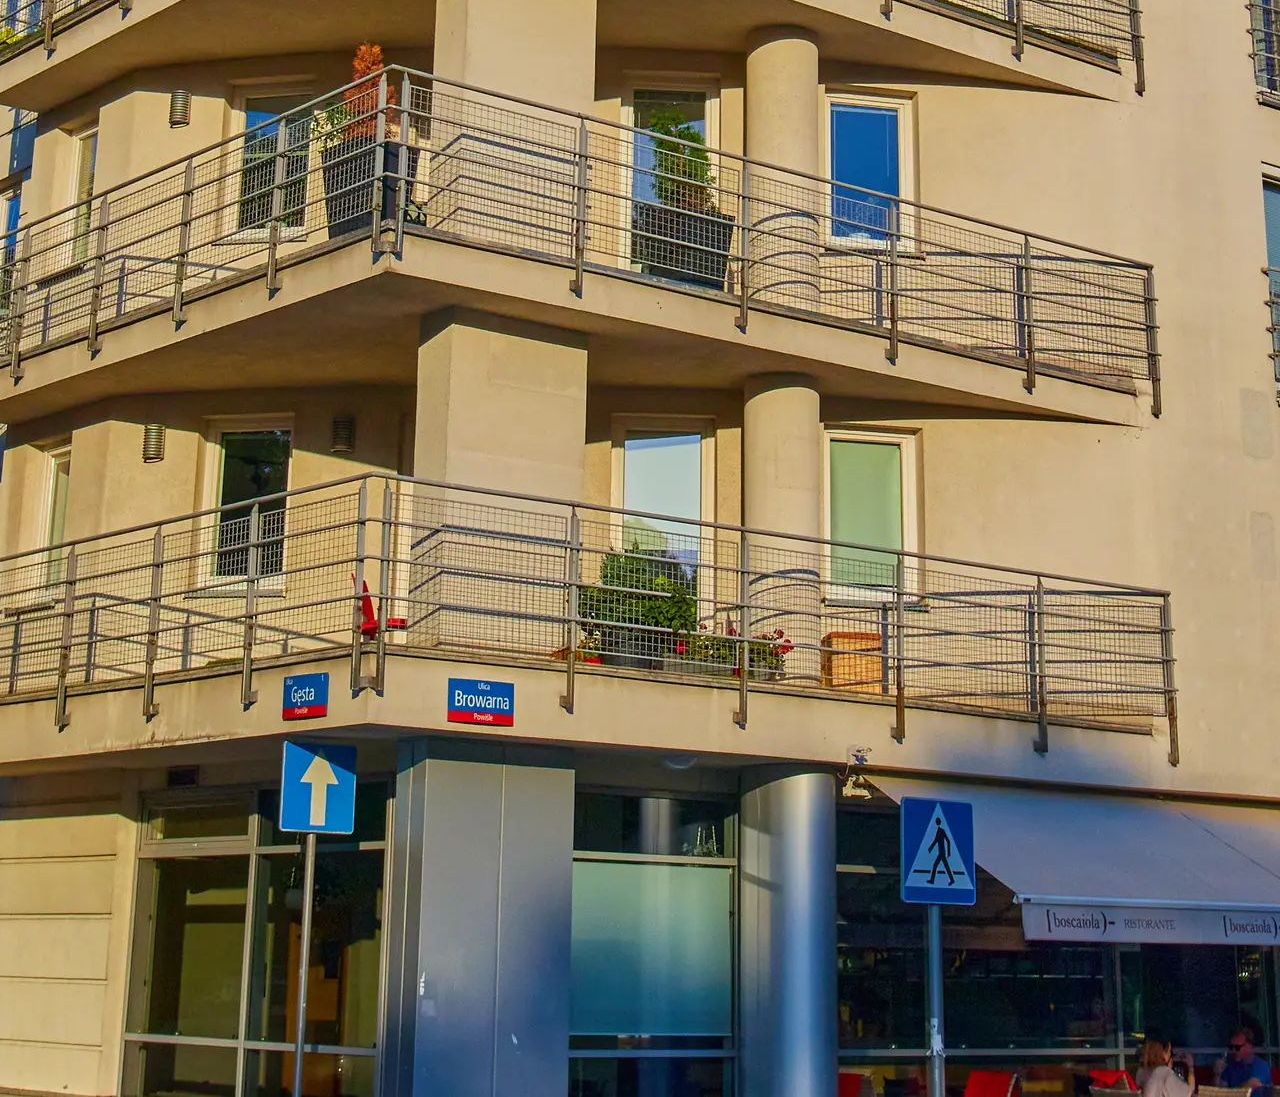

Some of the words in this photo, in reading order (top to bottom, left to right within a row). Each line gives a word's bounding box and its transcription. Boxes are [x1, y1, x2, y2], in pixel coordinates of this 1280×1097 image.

[477, 682, 491, 691] Ulica
[291, 686, 315, 706] Gęsta
[454, 689, 510, 710] Browarna
[473, 712, 494, 722] Powiśle
